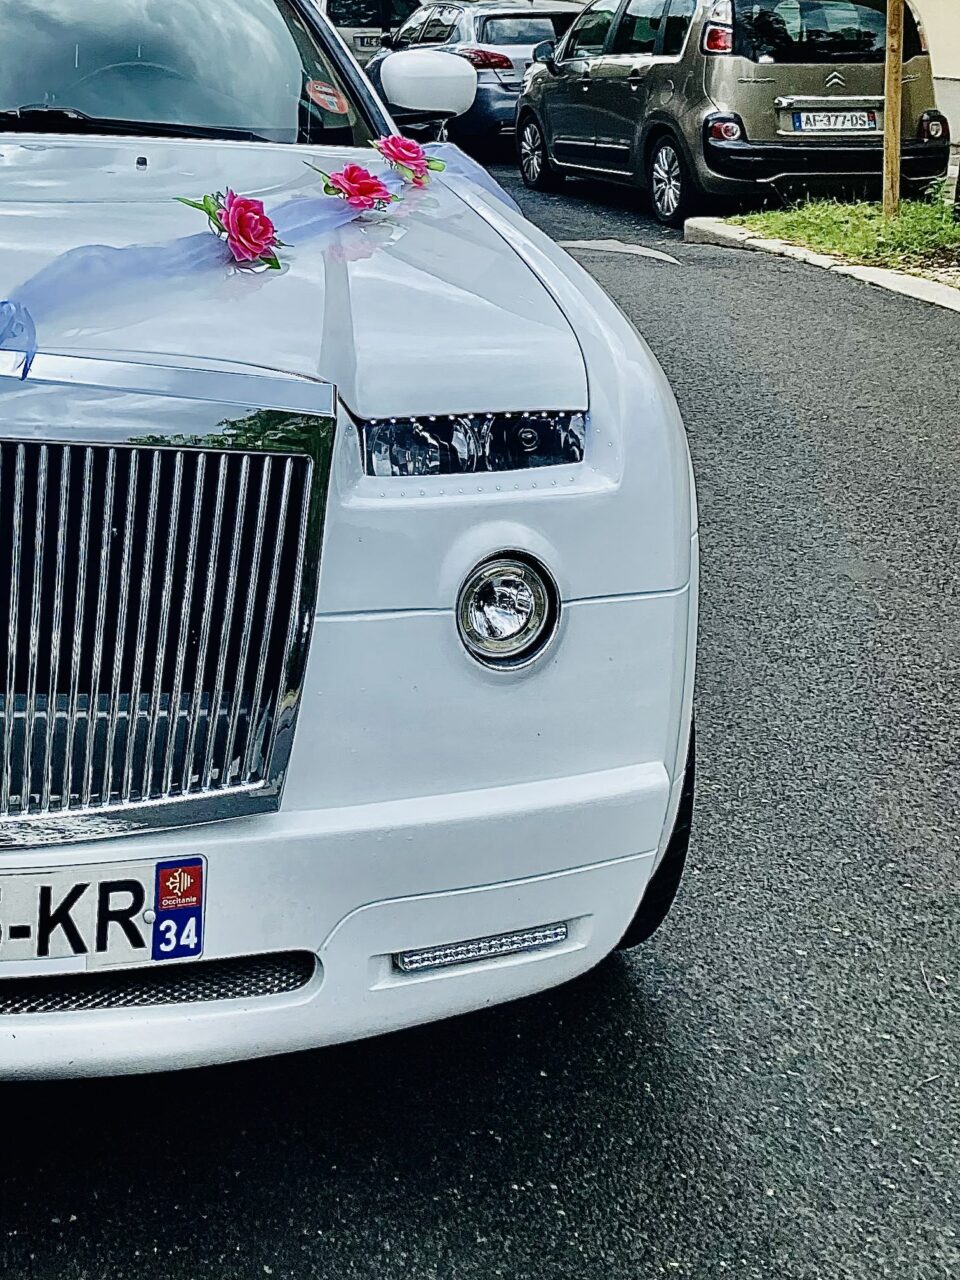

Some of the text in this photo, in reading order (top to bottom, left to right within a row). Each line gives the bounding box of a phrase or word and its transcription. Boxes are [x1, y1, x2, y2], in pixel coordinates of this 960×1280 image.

[804, 114, 867, 127] AF-377-DS
[162, 896, 197, 906] Occitanie
[159, 917, 198, 952] 34
